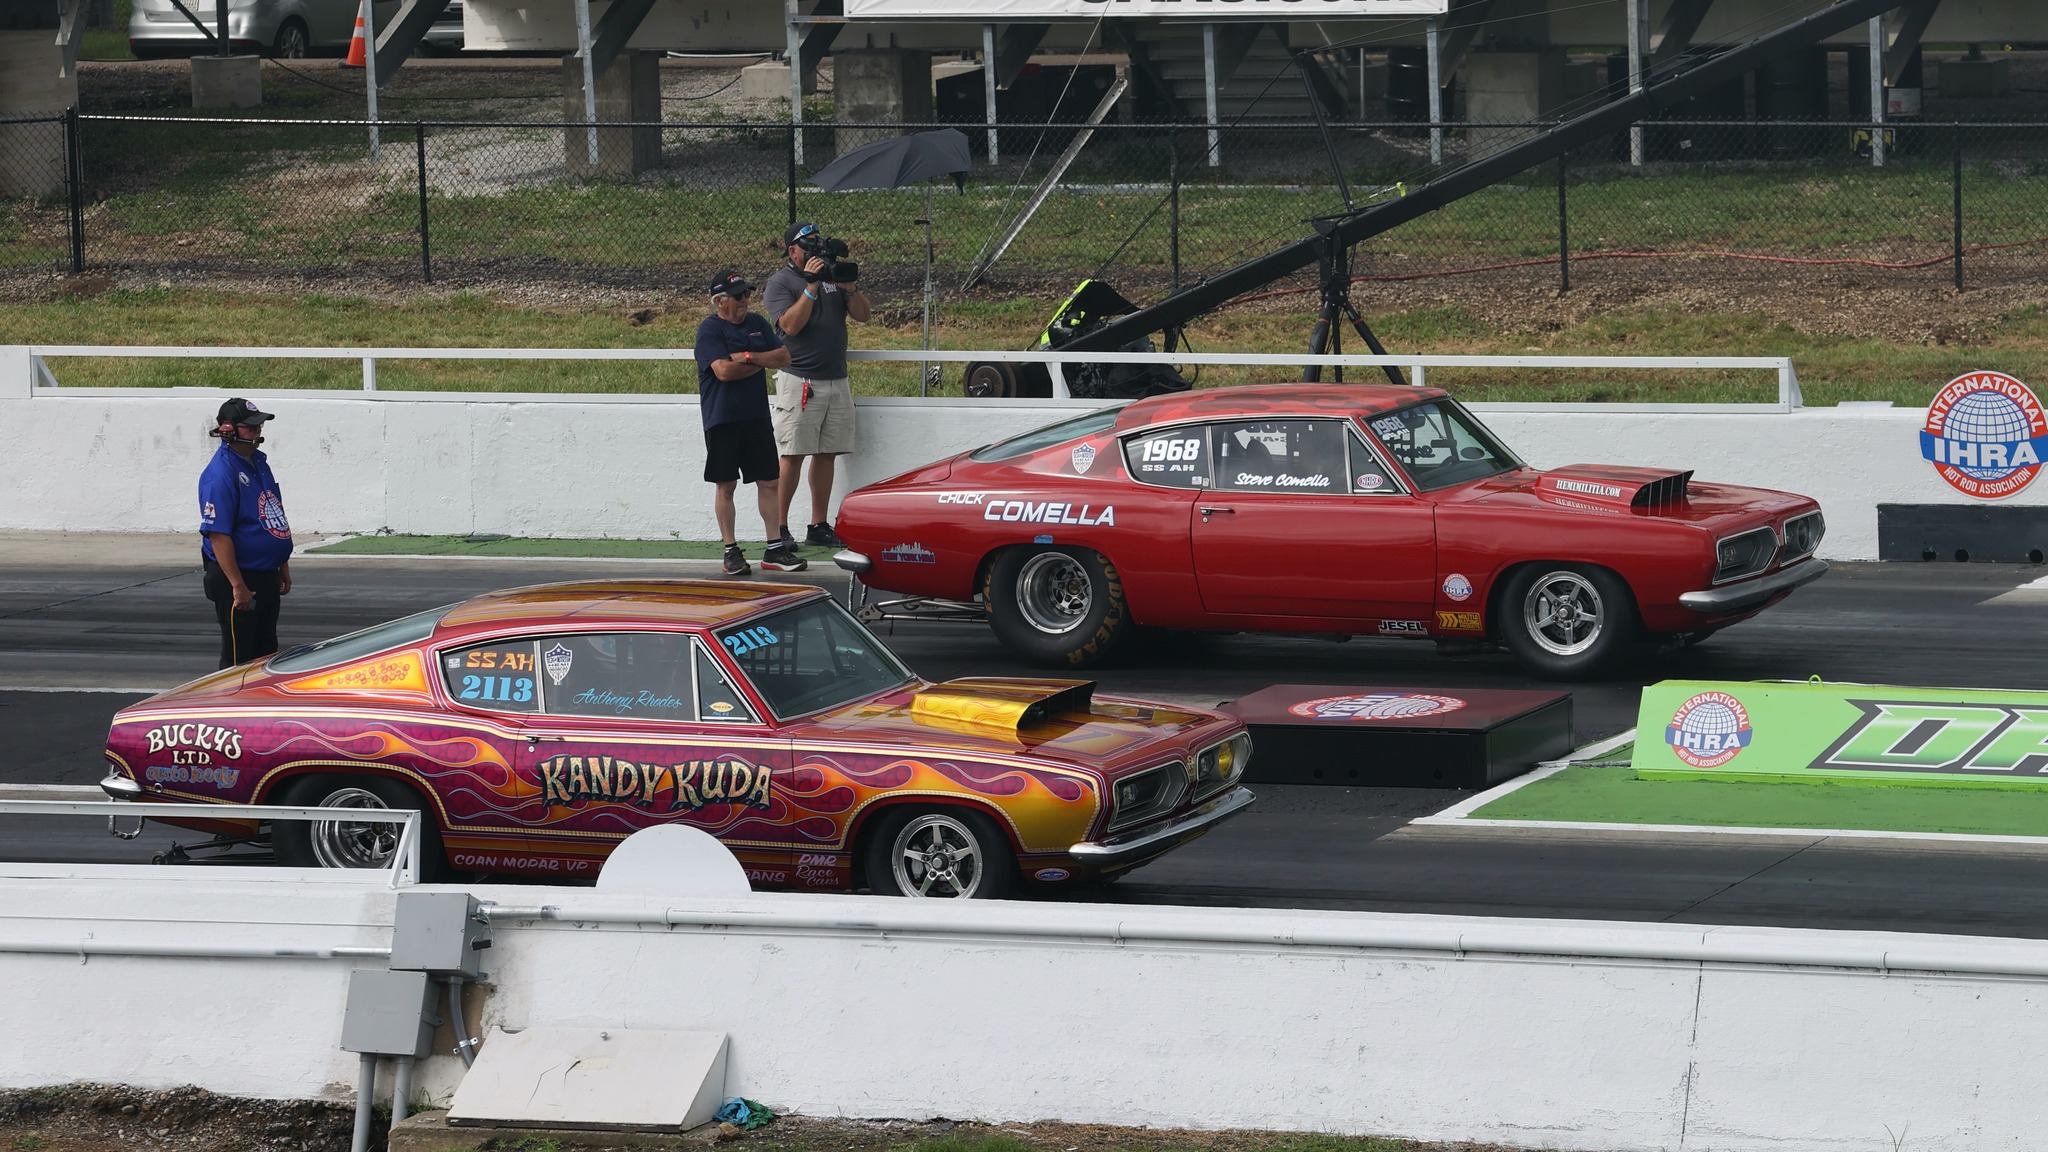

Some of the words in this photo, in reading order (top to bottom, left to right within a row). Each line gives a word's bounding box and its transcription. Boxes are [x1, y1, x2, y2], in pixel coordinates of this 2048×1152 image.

[1928, 375, 2044, 432] INTERNATIONAL
[1371, 416, 1406, 436] 1968
[1142, 438, 1200, 462] 1968
[1934, 437, 2040, 468] IHRA
[1142, 464, 1165, 472] SS
[1169, 464, 1195, 472] AH
[1234, 472, 1272, 486] Steve
[1275, 474, 1331, 487] Comella
[1361, 475, 1380, 486] NHRA
[1556, 479, 1621, 498] HEMIMILITIA.COM
[1944, 466, 1961, 483] HOT
[1960, 477, 1978, 492] ROD
[1979, 467, 2032, 494] ASSOCIATION
[938, 492, 986, 505] CHUCK
[265, 516, 289, 528] IHR
[983, 500, 1115, 527] COMELLA
[1446, 586, 1469, 595] IHRA
[1380, 621, 1426, 631] JESEL
[723, 625, 779, 657] 2113
[466, 651, 498, 669] SS
[500, 651, 535, 672] AH
[459, 674, 534, 703] 2113
[573, 687, 635, 714] Anthony
[634, 689, 682, 709] Rhodes
[1673, 692, 1748, 728] INTERNATIONAL
[1673, 730, 1741, 750] IHRA
[172, 750, 213, 766] LTD.
[1677, 748, 1689, 760] HOT
[1687, 755, 1699, 765] ROD
[1699, 750, 1735, 767] ASSOCIATION
[146, 765, 189, 783] auto
[540, 755, 667, 806] KANDY
[673, 760, 773, 808] KUDA
[454, 854, 498, 867] COAN
[503, 857, 560, 871] MOPAR
[566, 860, 588, 871] VP
[798, 853, 837, 867] PMR
[795, 865, 834, 880] Race
